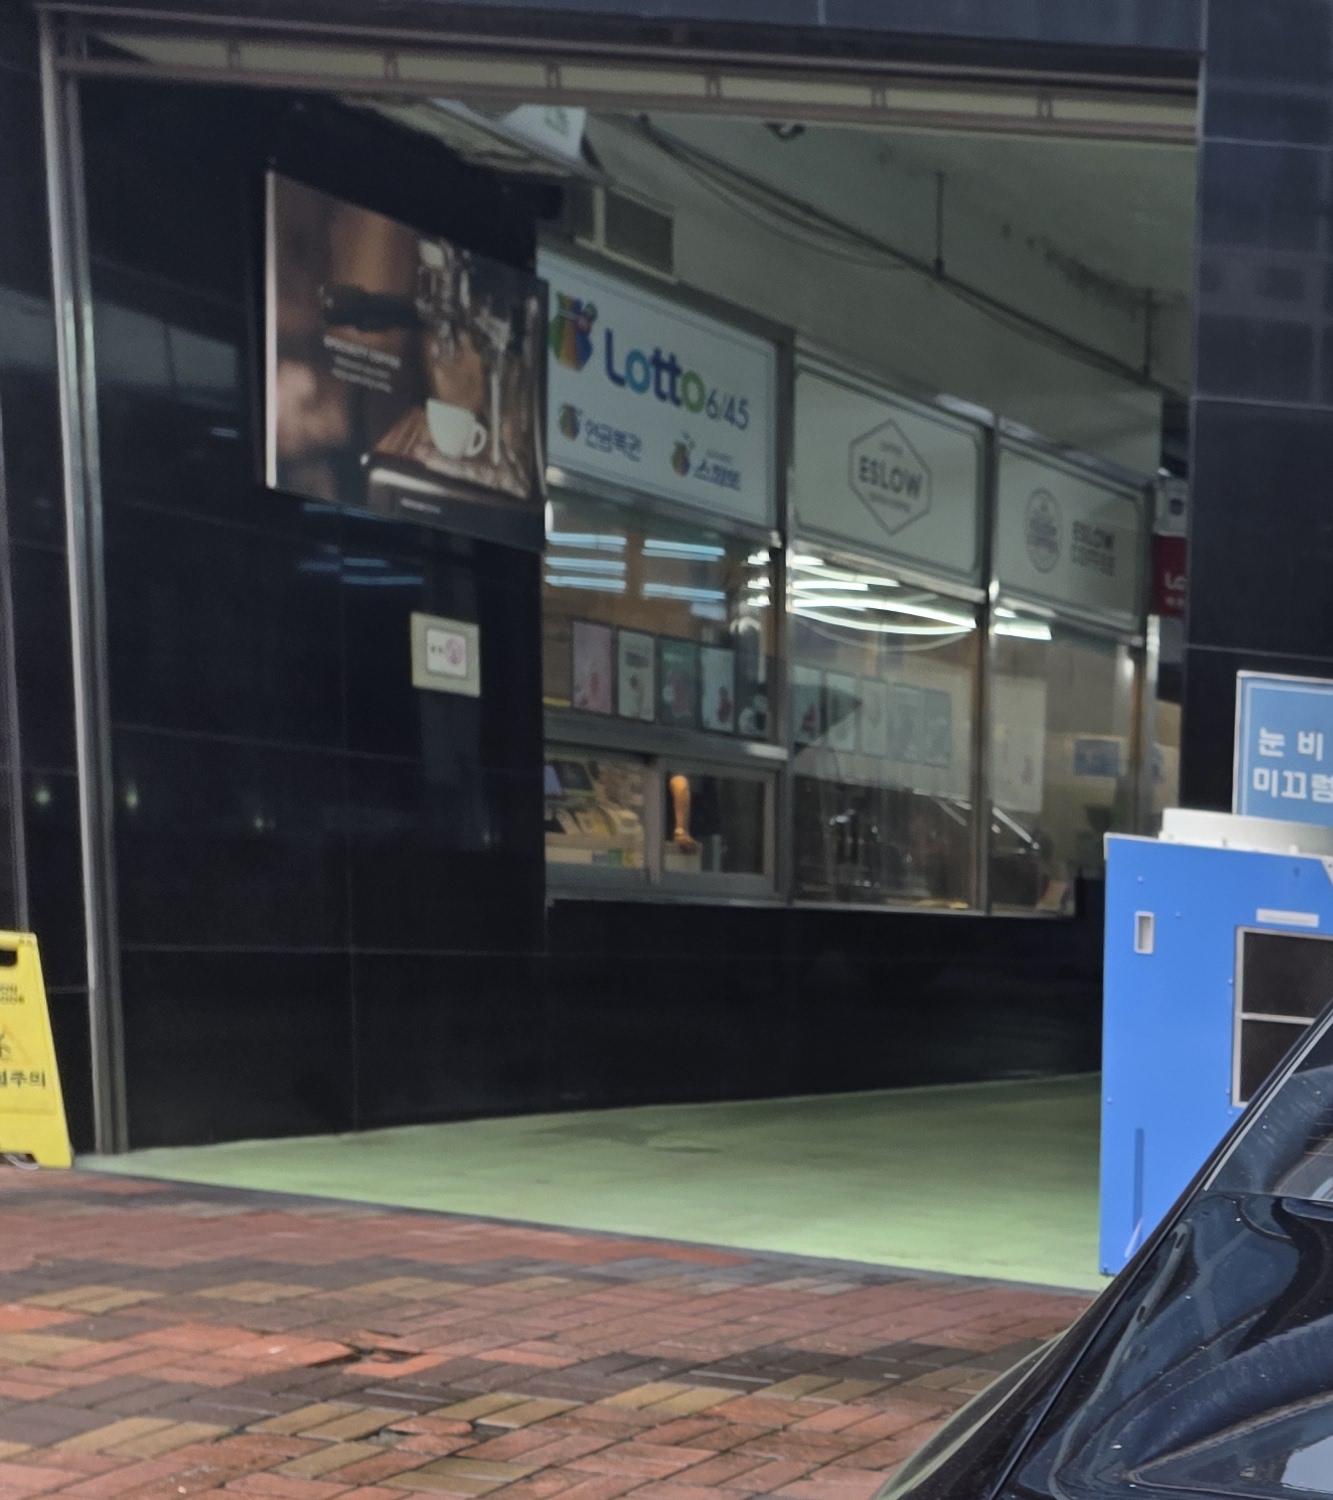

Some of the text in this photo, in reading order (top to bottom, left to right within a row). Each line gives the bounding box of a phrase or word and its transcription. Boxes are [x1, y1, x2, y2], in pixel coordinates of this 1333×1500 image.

[605, 327, 704, 413] Lotto
[858, 455, 923, 499] ESLOW
[1258, 726, 1285, 758] 눈
[1297, 731, 1324, 762] 비
